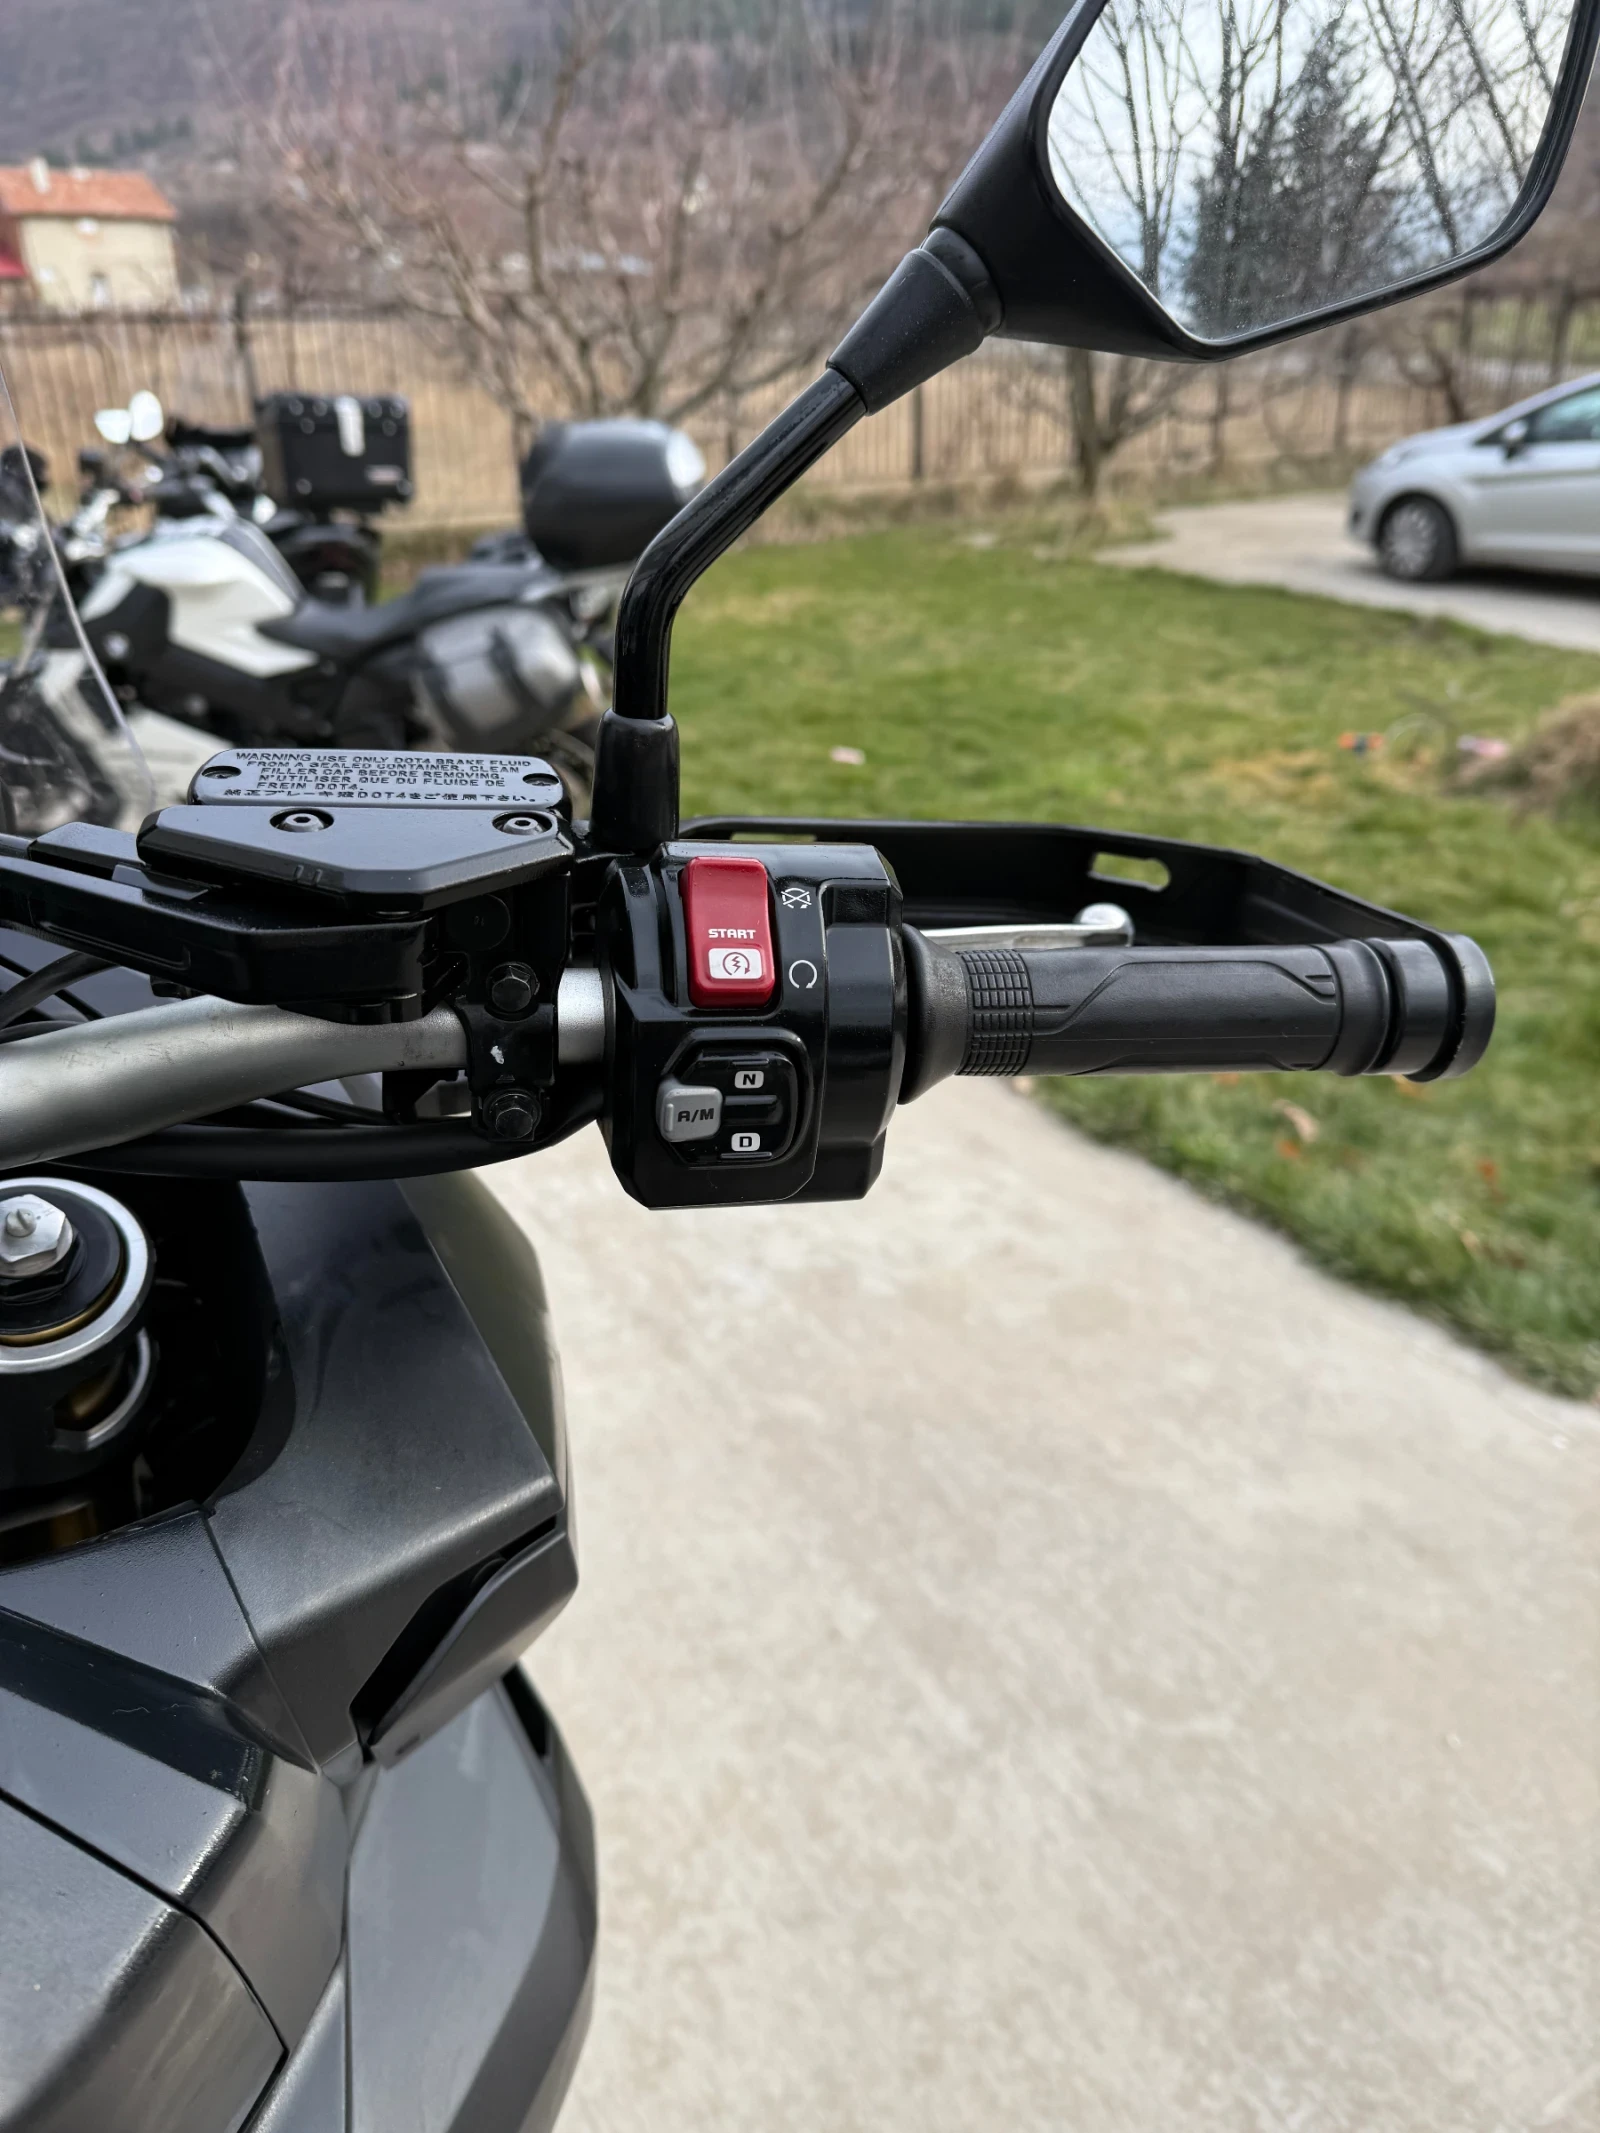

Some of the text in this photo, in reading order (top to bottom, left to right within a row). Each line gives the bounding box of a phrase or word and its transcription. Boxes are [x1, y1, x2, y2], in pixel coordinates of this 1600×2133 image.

[237, 752, 312, 762] WARNING
[316, 755, 347, 763] USE
[261, 767, 317, 775] FILLER
[359, 769, 418, 777] BEFORE
[423, 770, 505, 780] REMOVING.
[470, 765, 519, 773] CLEAN
[256, 782, 307, 790] FREIN
[359, 776, 390, 784] QUE
[423, 778, 479, 787] FLUIDE
[485, 779, 505, 787] DE
[708, 929, 756, 940] START
[743, 1074, 756, 1085] N
[677, 1108, 715, 1123] A/M
[739, 1136, 753, 1148] D
